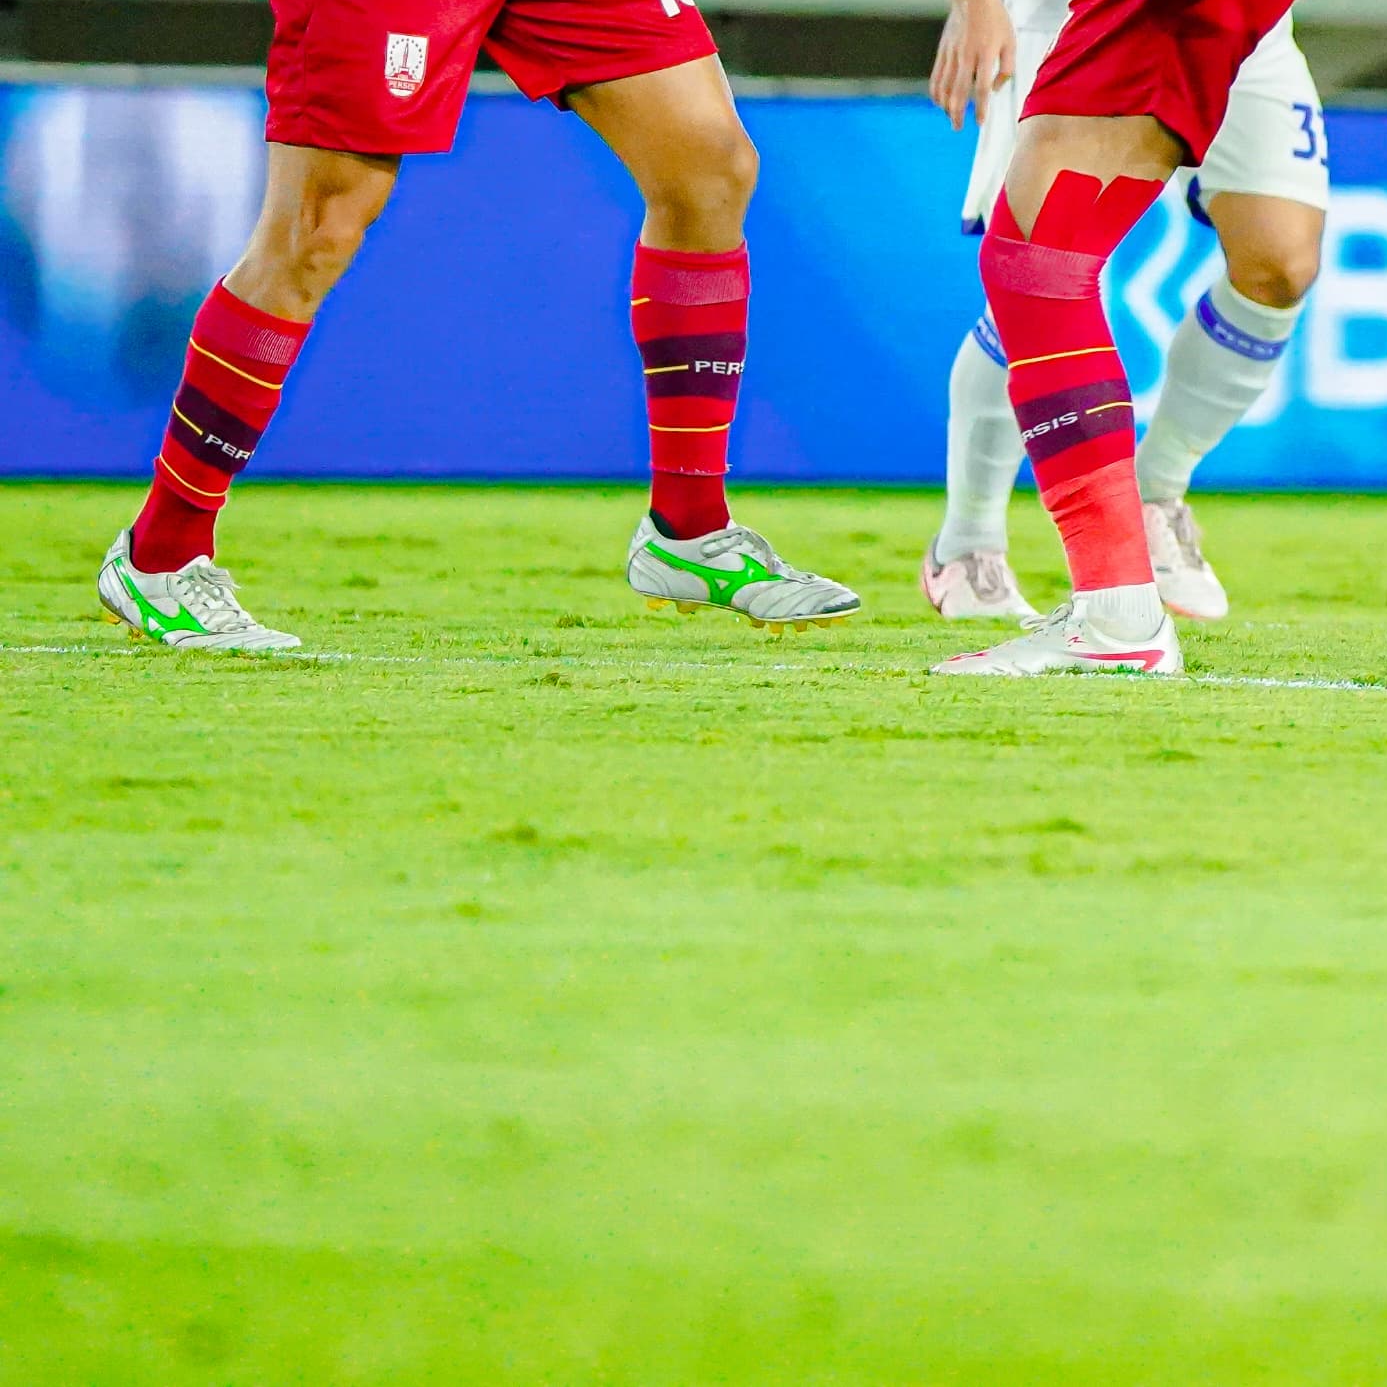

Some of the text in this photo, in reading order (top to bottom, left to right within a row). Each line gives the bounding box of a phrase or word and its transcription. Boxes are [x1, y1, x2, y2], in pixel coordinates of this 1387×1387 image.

[1292, 102, 1329, 166] 3
[694, 360, 745, 376] PER
[204, 433, 256, 461] PER
